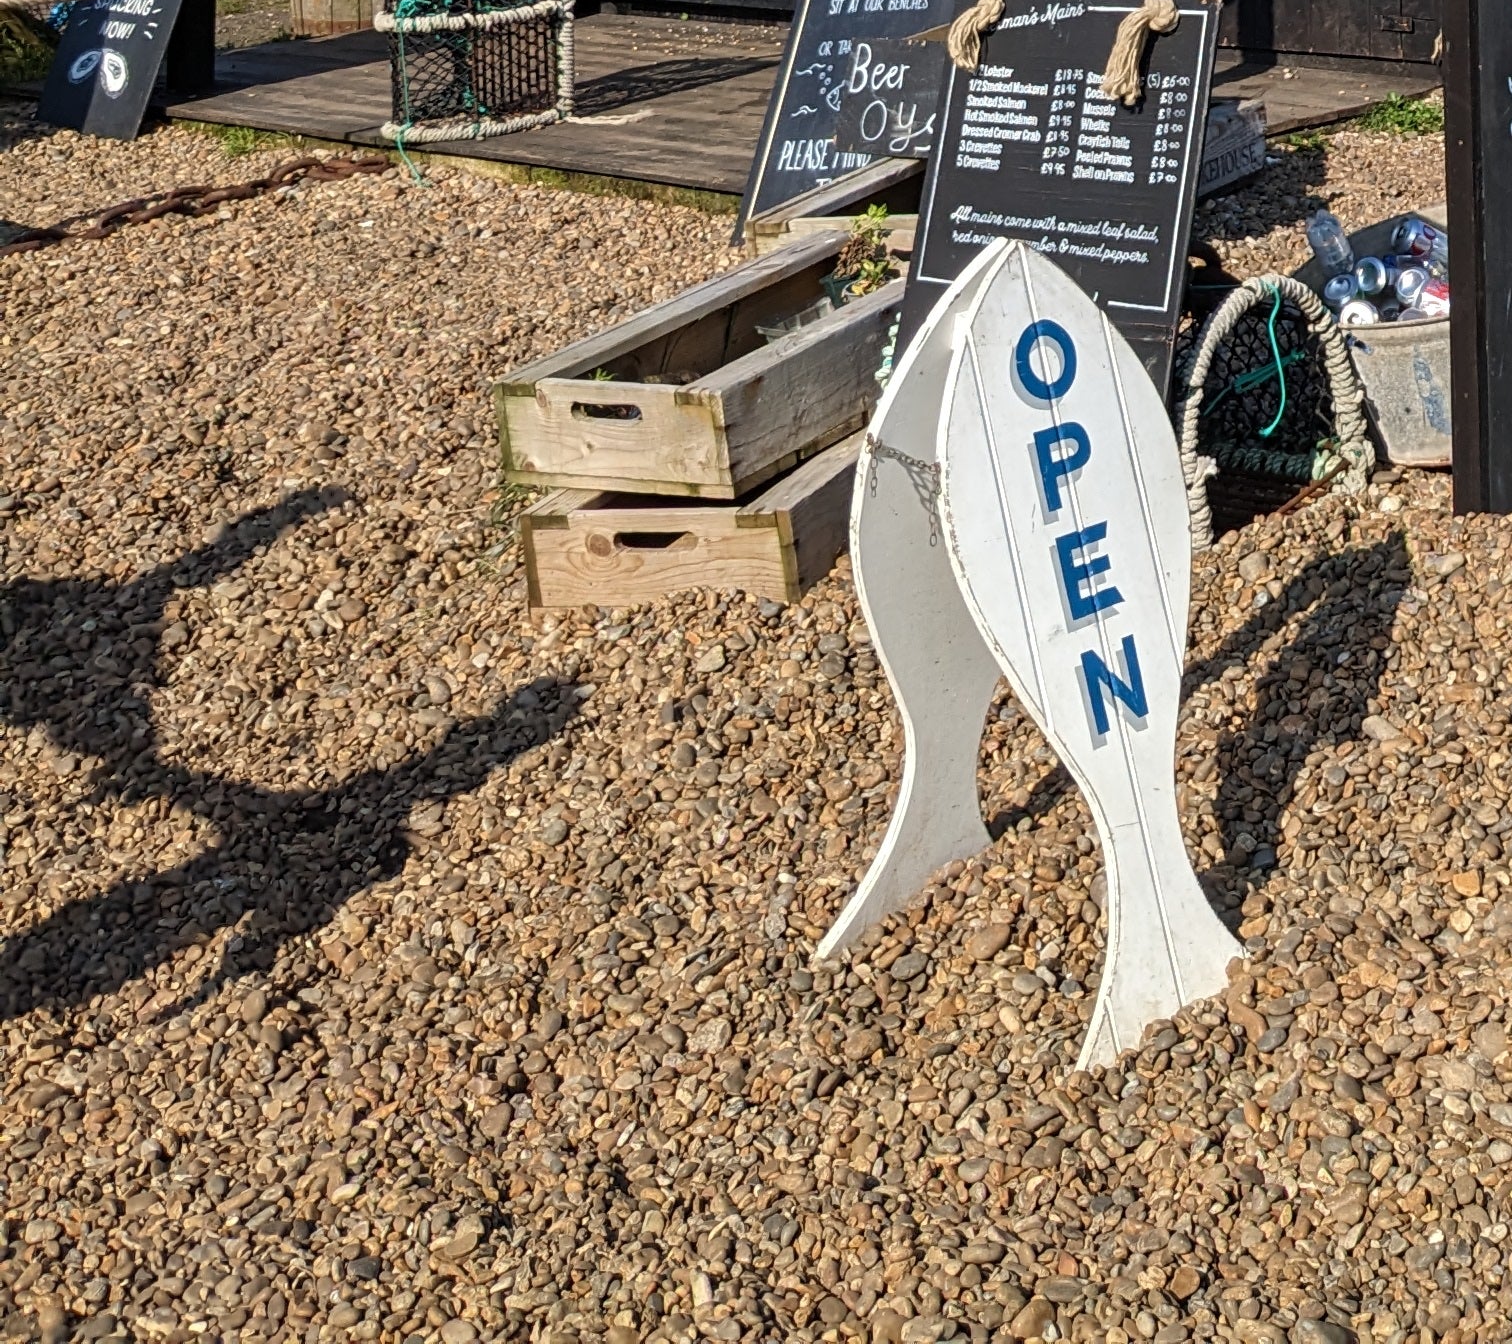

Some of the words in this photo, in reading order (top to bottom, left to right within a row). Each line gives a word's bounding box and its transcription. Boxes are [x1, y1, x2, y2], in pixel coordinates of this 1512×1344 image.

[1041, 3, 1086, 25] Mains
[102, 20, 135, 39] NOW!
[818, 41, 833, 56] OR
[849, 43, 911, 93] Beer
[777, 139, 834, 171] PLEASE
[950, 205, 970, 225] All
[969, 211, 1003, 225] mains
[1004, 216, 1032, 228] come
[1032, 216, 1057, 231] with
[1057, 221, 1067, 231] a
[1068, 220, 1101, 235] mixed
[1101, 221, 1127, 239] leaf
[1070, 241, 1102, 257] mixed
[1015, 318, 1149, 735] OPEN
